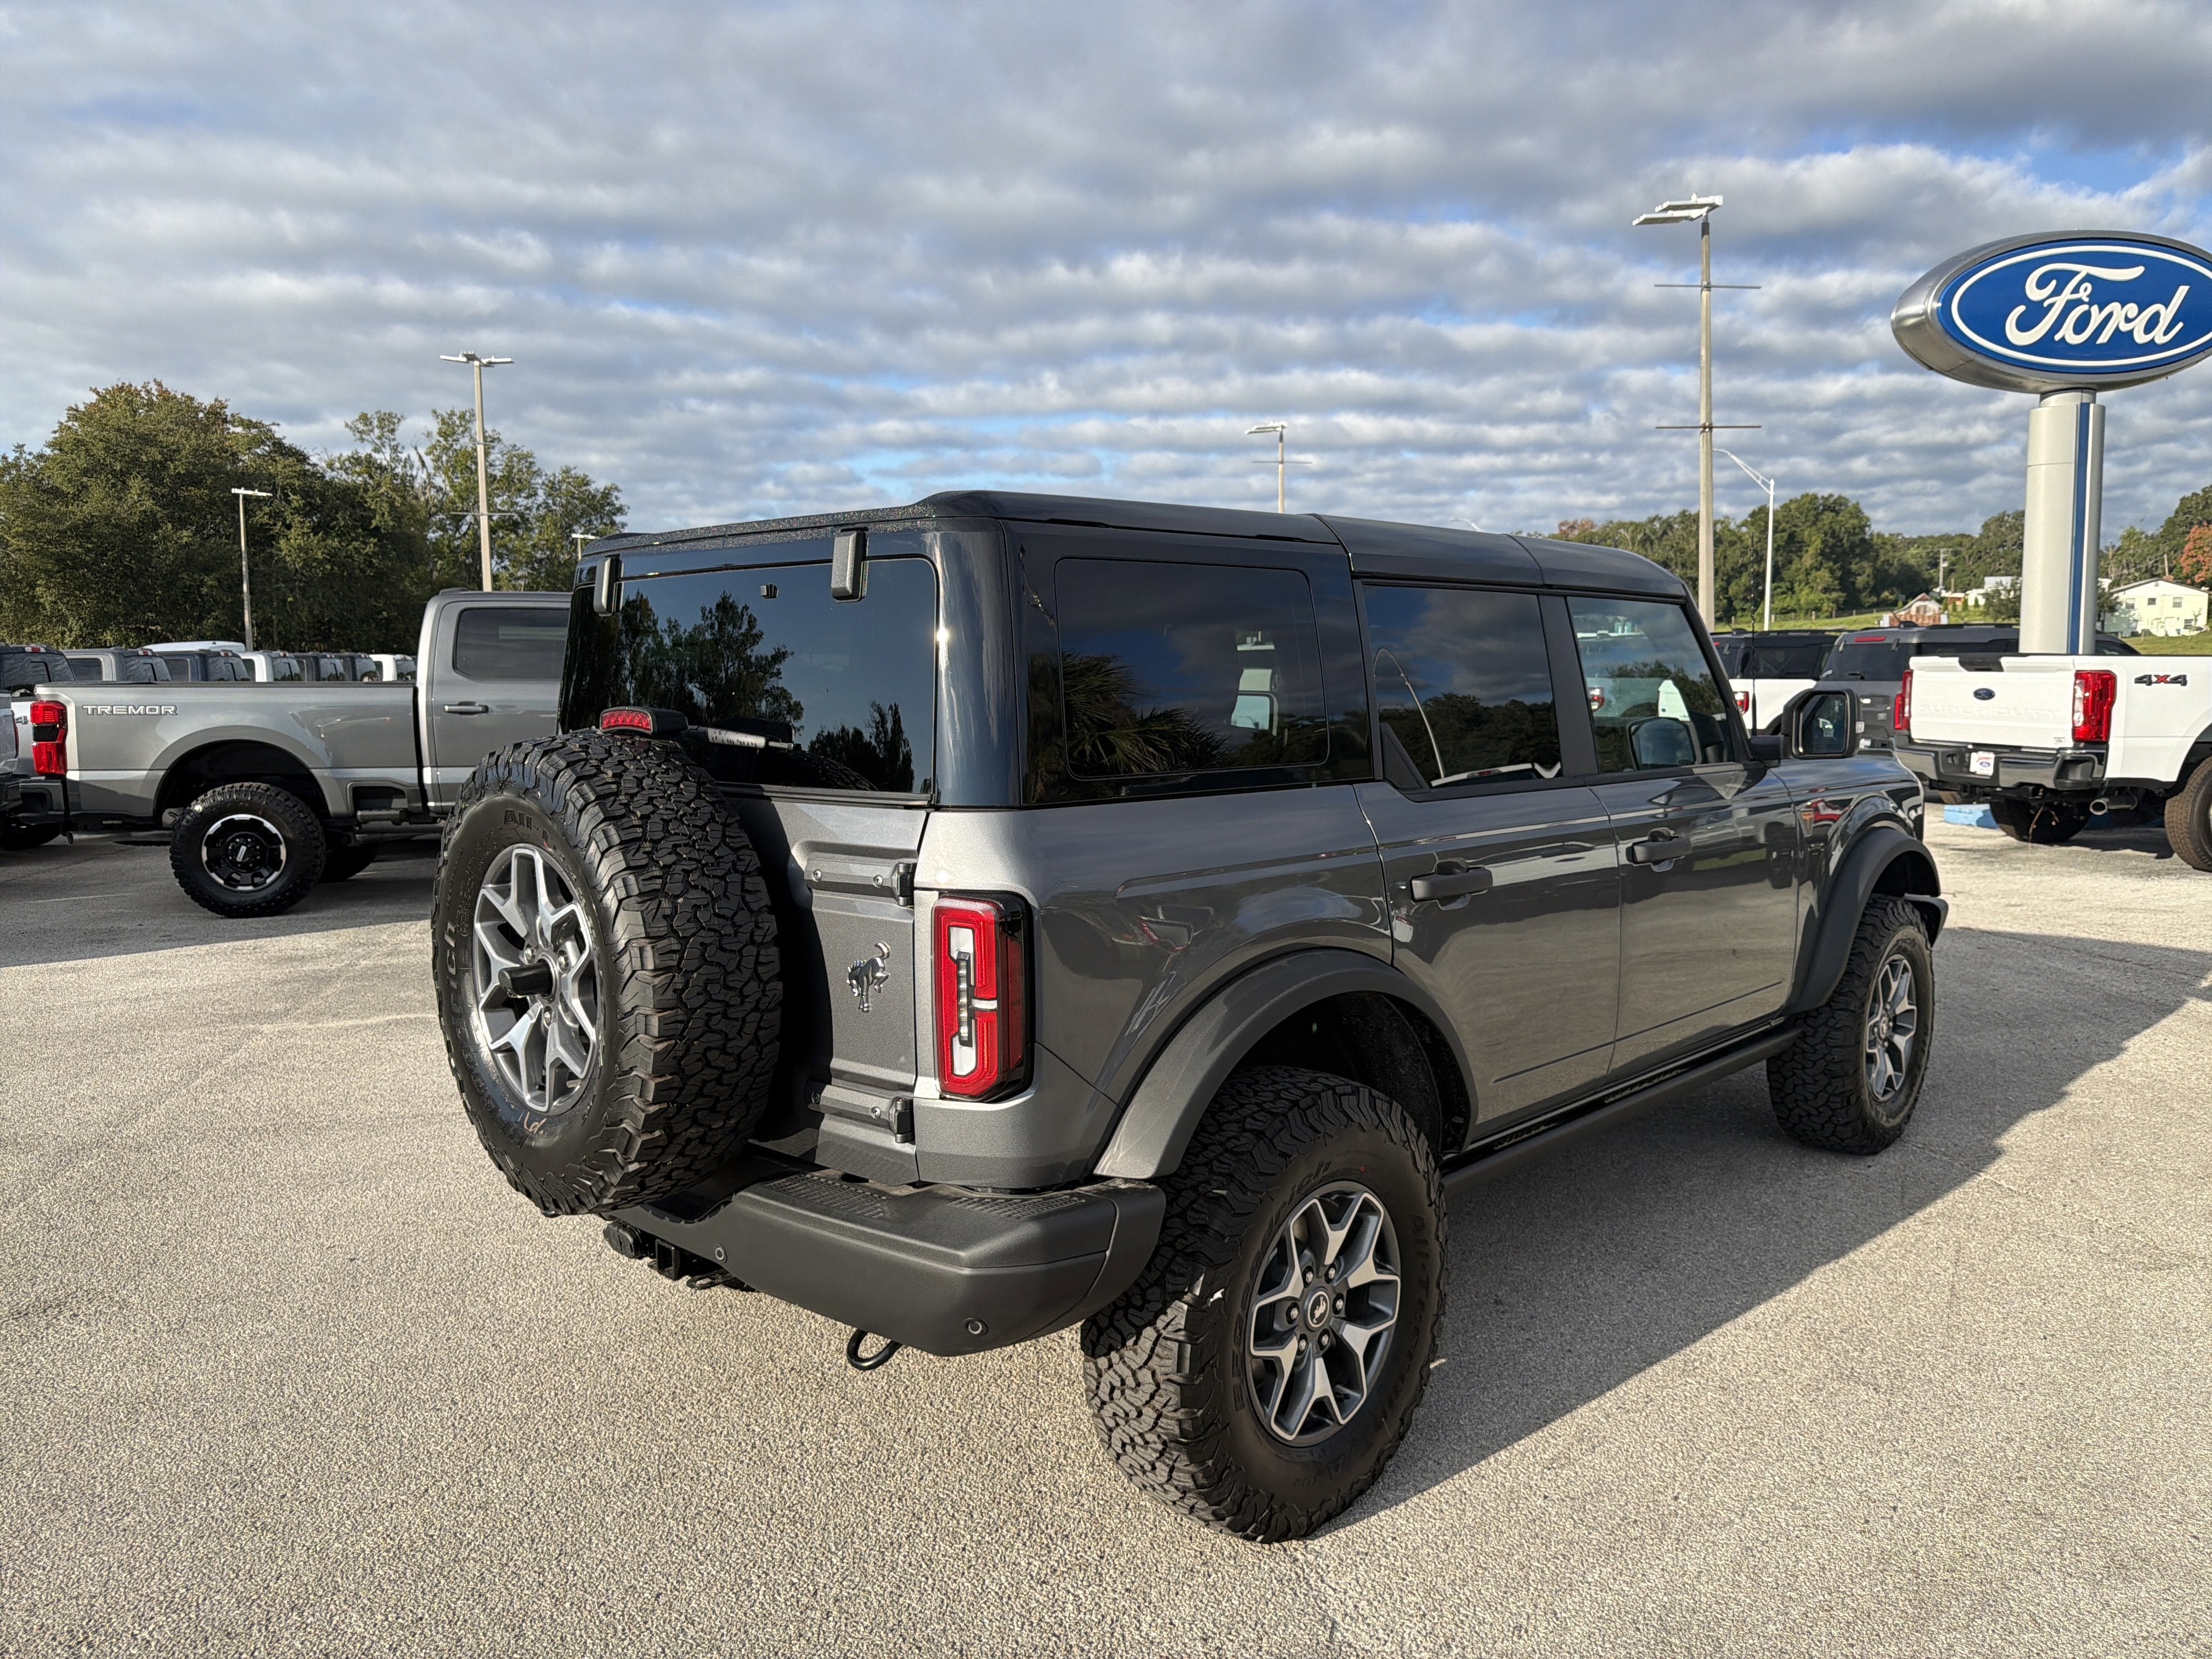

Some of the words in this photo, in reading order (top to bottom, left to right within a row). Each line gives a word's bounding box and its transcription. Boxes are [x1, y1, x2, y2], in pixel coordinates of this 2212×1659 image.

[2005, 263, 2190, 346] Ford
[82, 704, 178, 716] TREMOR
[1918, 704, 1987, 716] SUPER
[1996, 707, 2061, 719] DUTY
[444, 921, 528, 1148] BFGoodrich
